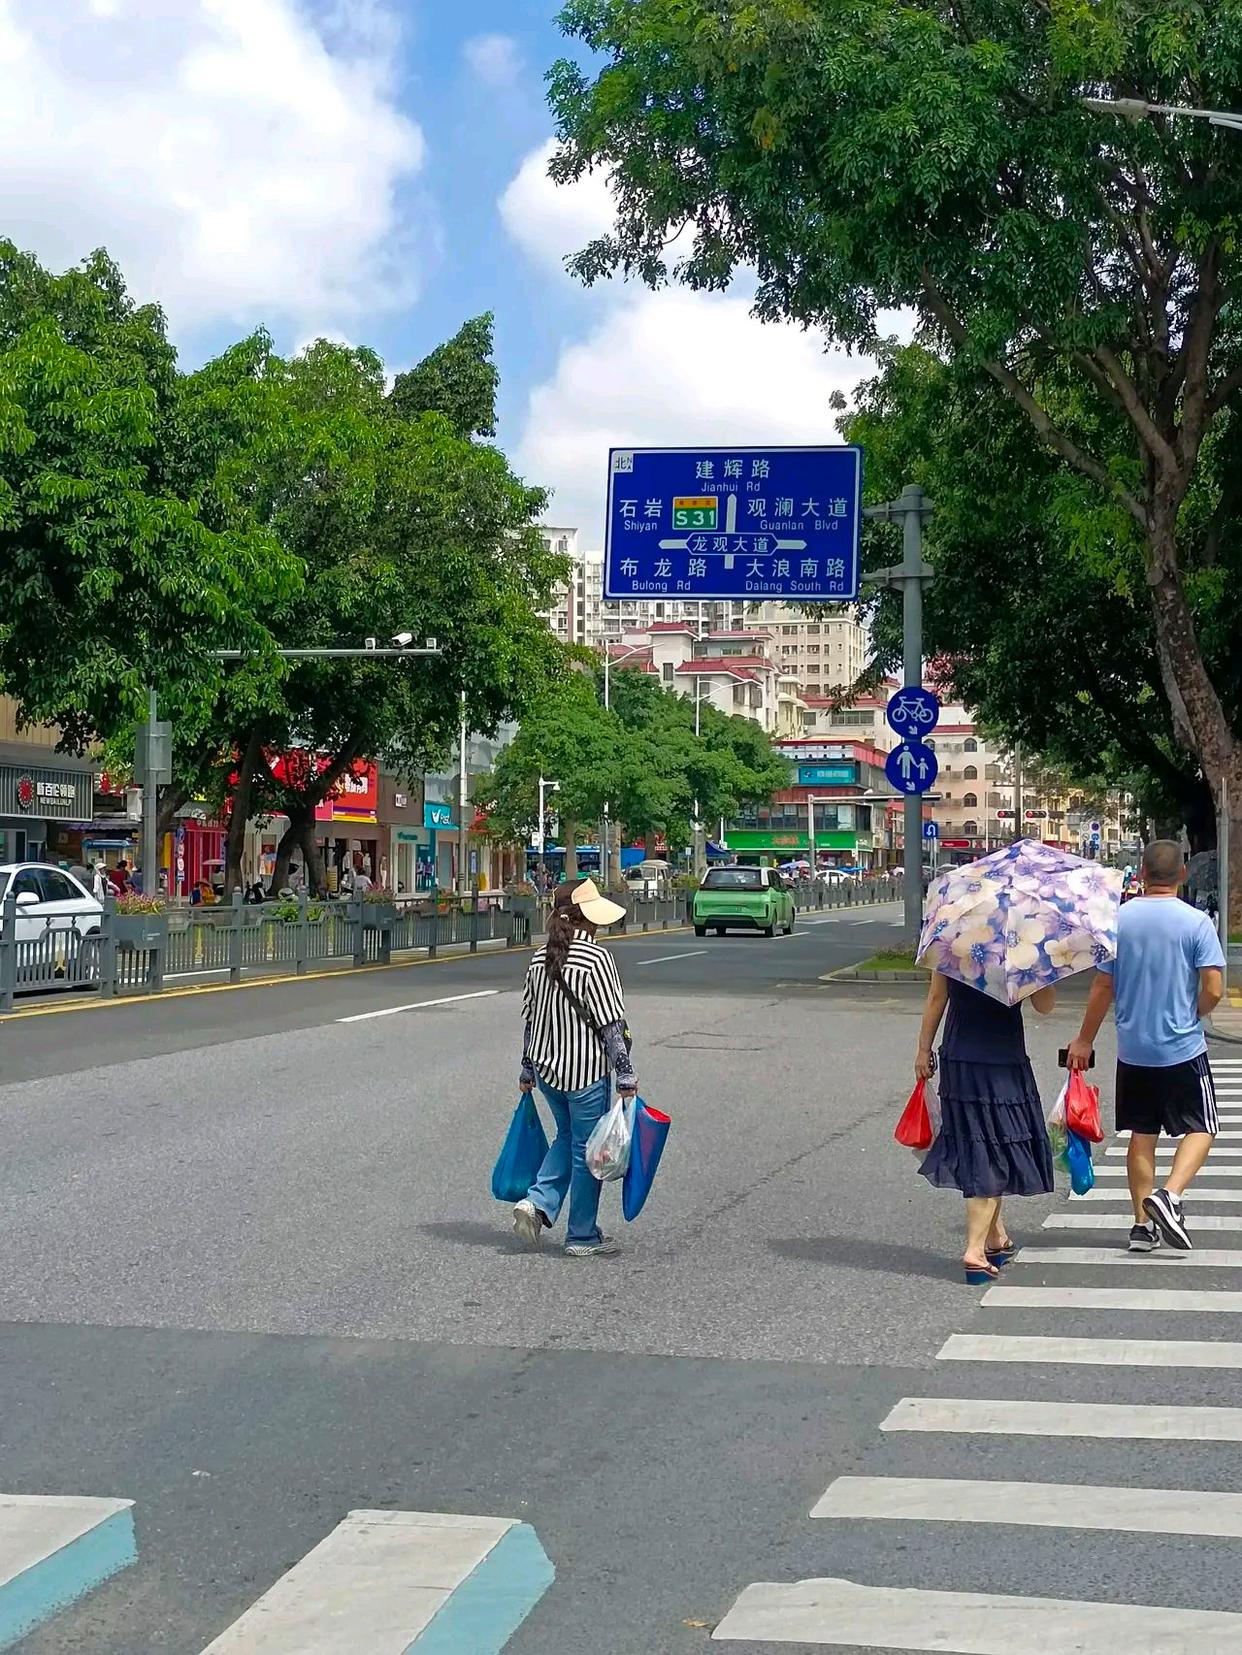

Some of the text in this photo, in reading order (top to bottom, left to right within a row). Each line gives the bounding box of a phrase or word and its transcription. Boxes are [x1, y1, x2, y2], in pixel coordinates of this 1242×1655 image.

[695, 458, 770, 479] 建辉路
[701, 481, 761, 493] Jianhui Rd
[619, 497, 663, 518] 石岩
[747, 497, 848, 517] 观澜大道
[676, 510, 715, 526] S31
[760, 519, 839, 531] Guanlan Blvd
[624, 520, 658, 533] Shiyan
[692, 536, 769, 553] 龙观大道
[620, 557, 707, 578] 布龙路
[745, 557, 846, 579] 大浪南路
[632, 580, 691, 593] Bulong Rd
[745, 580, 845, 593] Dalang South Rd
